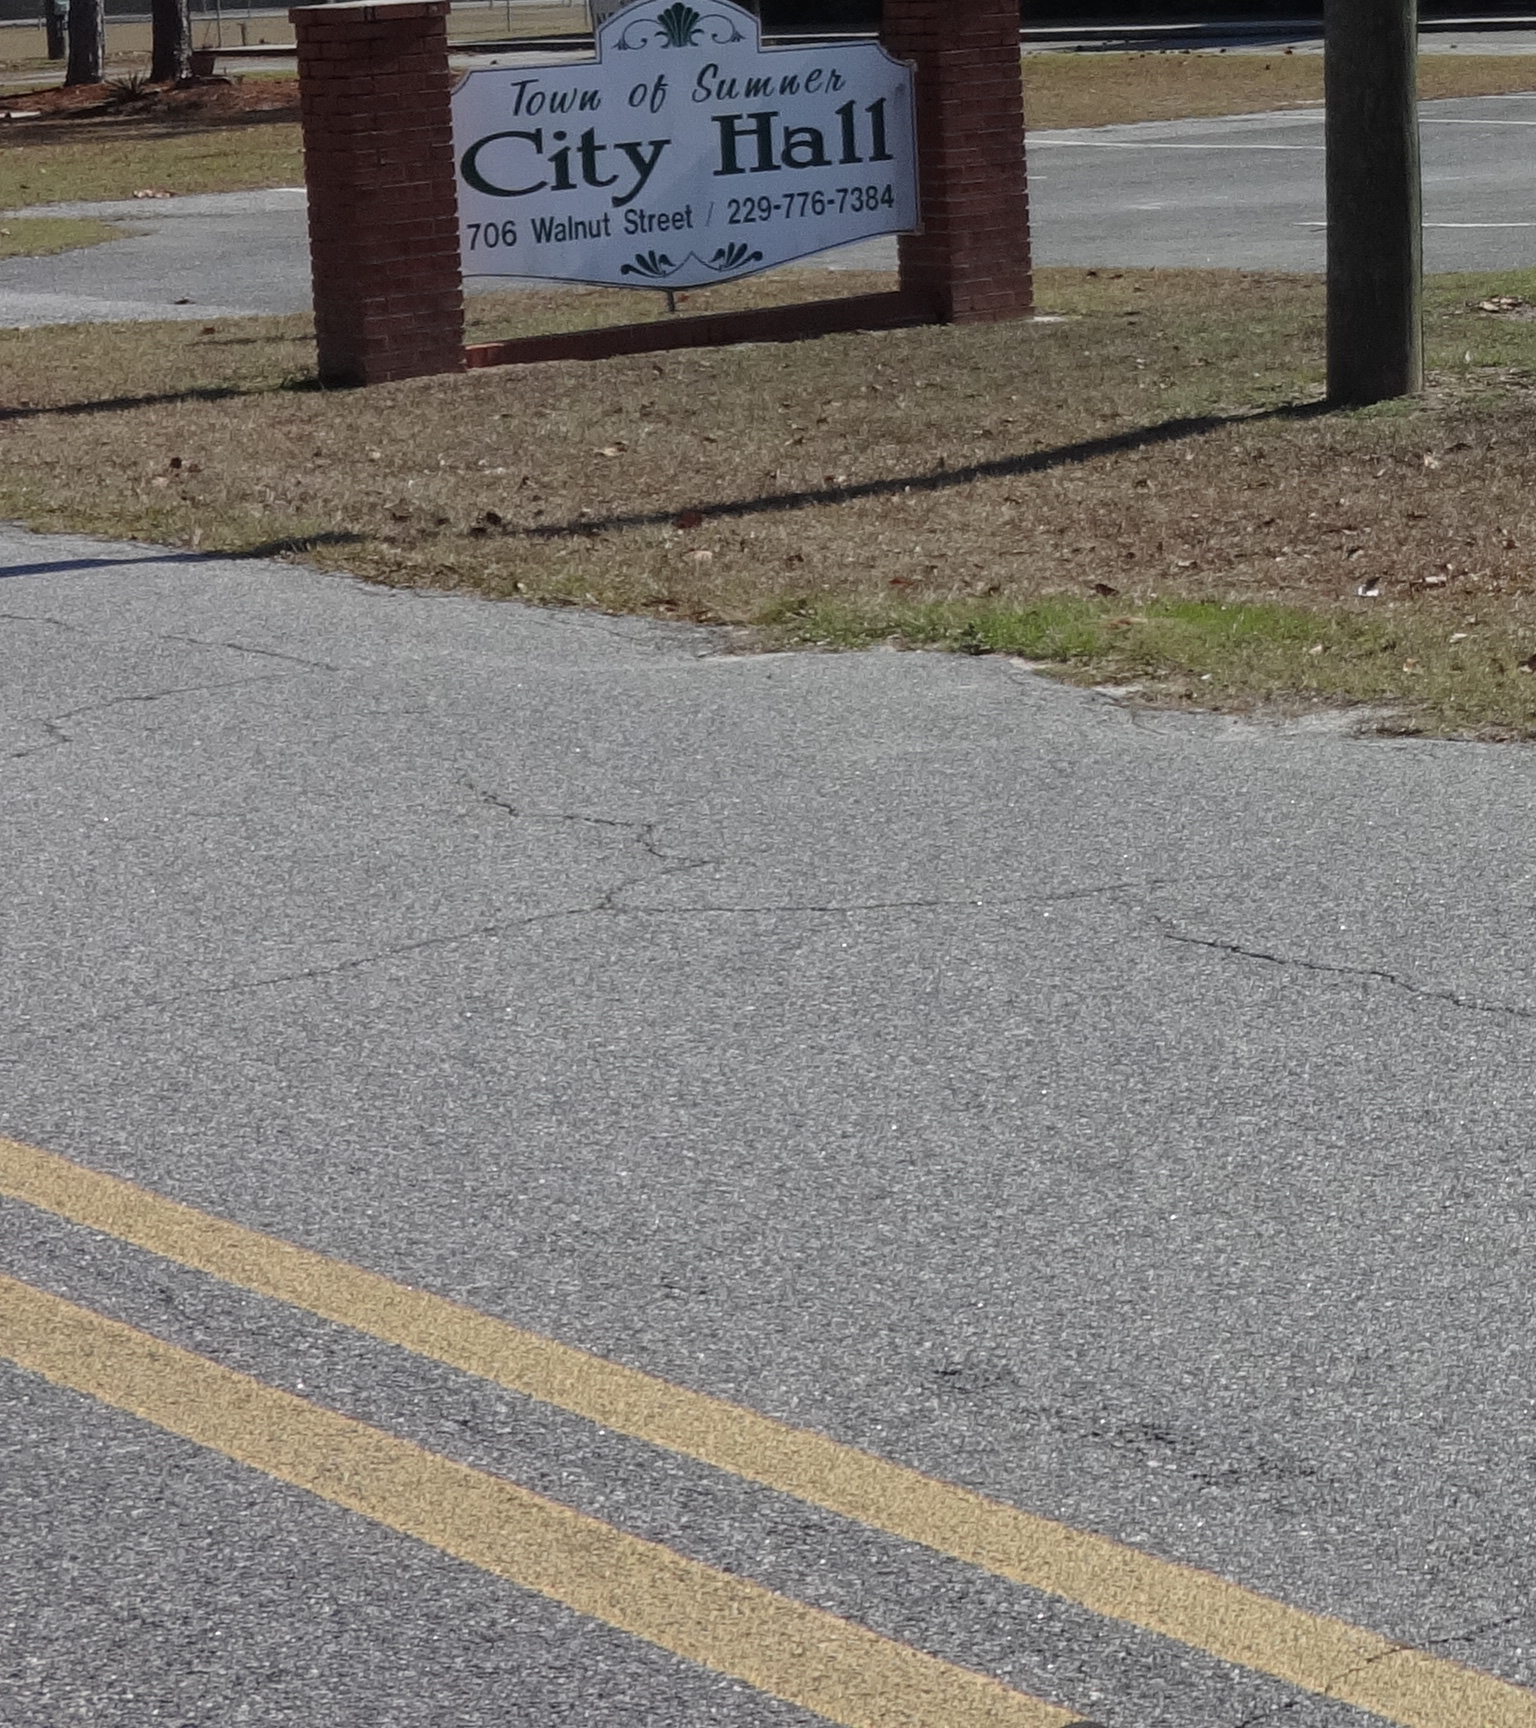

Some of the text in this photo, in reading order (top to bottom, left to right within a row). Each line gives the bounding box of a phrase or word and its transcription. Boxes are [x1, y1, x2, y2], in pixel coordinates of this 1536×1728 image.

[510, 62, 847, 116] Town of Sumner
[459, 97, 894, 208] City Hall
[466, 220, 518, 251] 706
[530, 212, 611, 244] Walnut
[623, 204, 694, 236] Street
[727, 183, 896, 225] 229-776-7384
